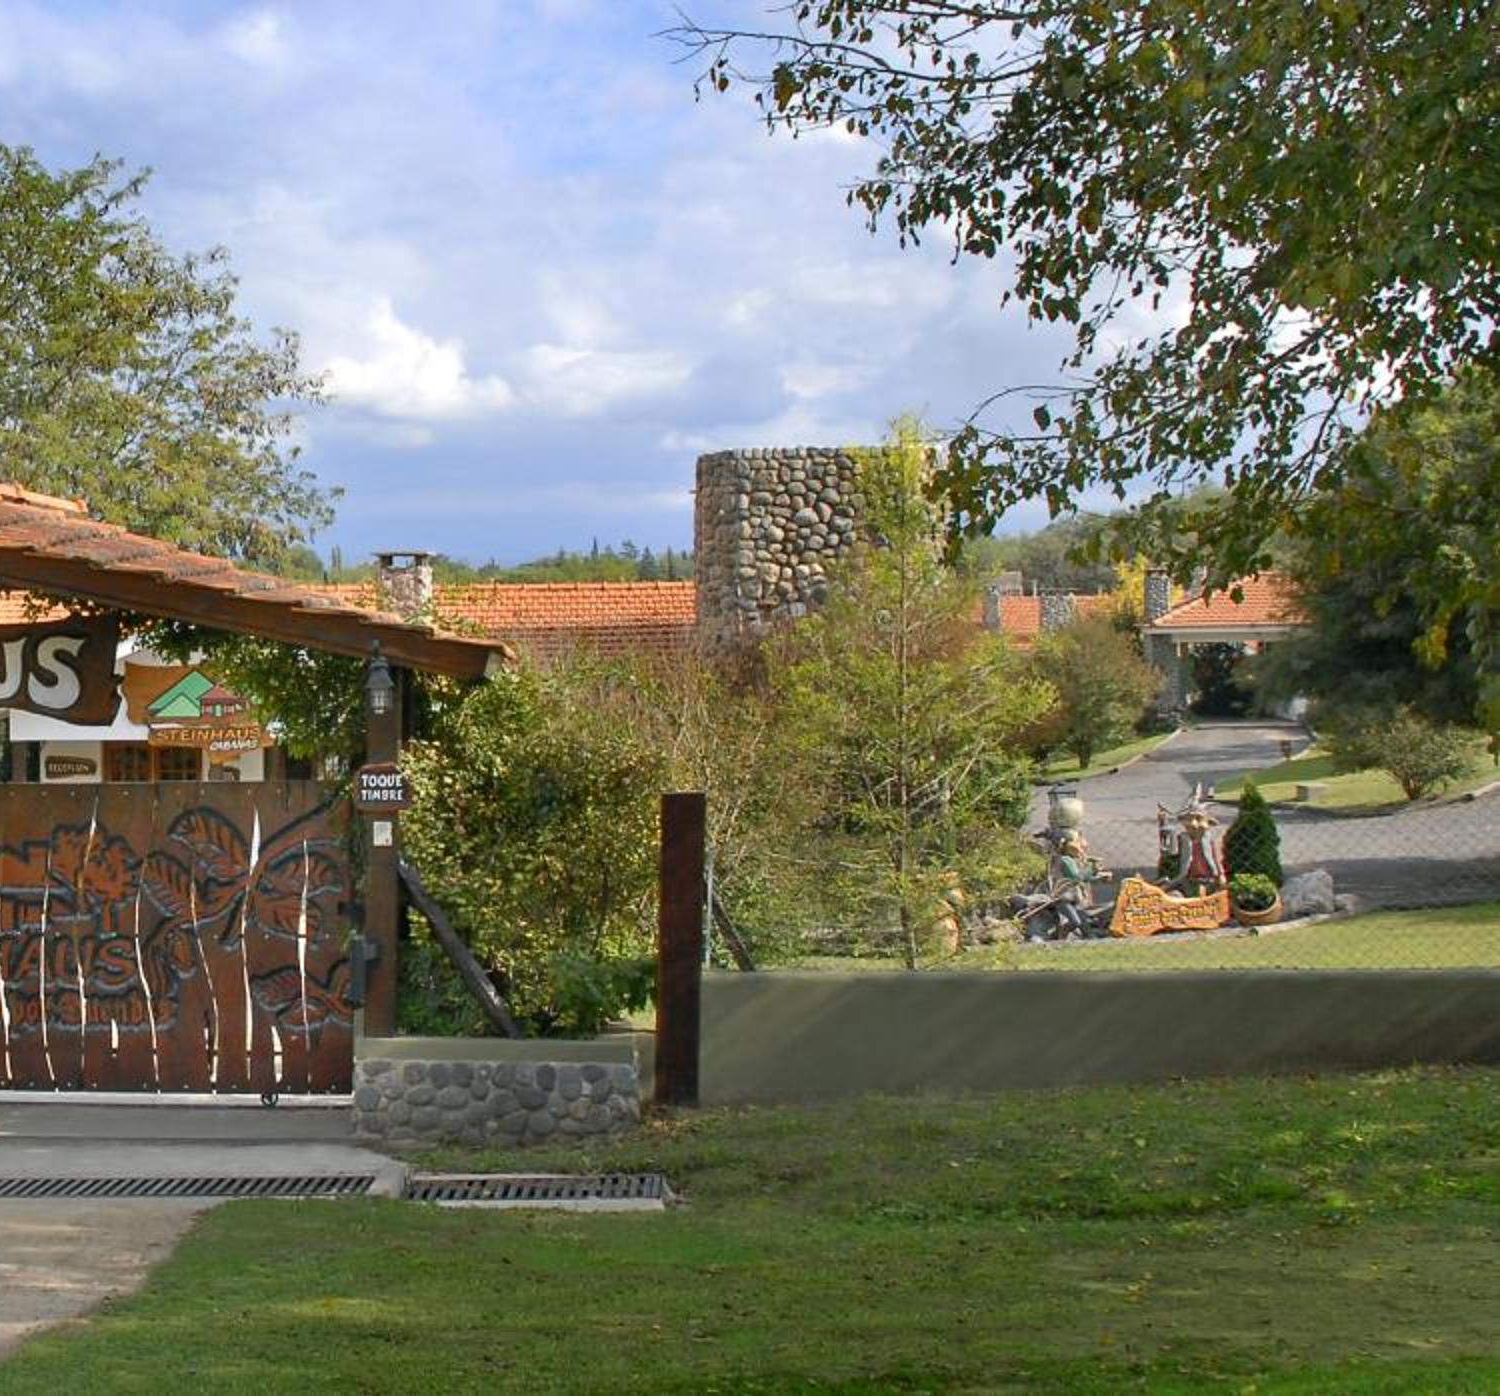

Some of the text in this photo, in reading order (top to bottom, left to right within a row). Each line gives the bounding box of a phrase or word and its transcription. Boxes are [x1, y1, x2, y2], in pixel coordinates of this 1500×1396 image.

[156, 726, 260, 741] STEINHAUS
[361, 774, 402, 787] TOQUE
[361, 790, 402, 801] TIMBRE
